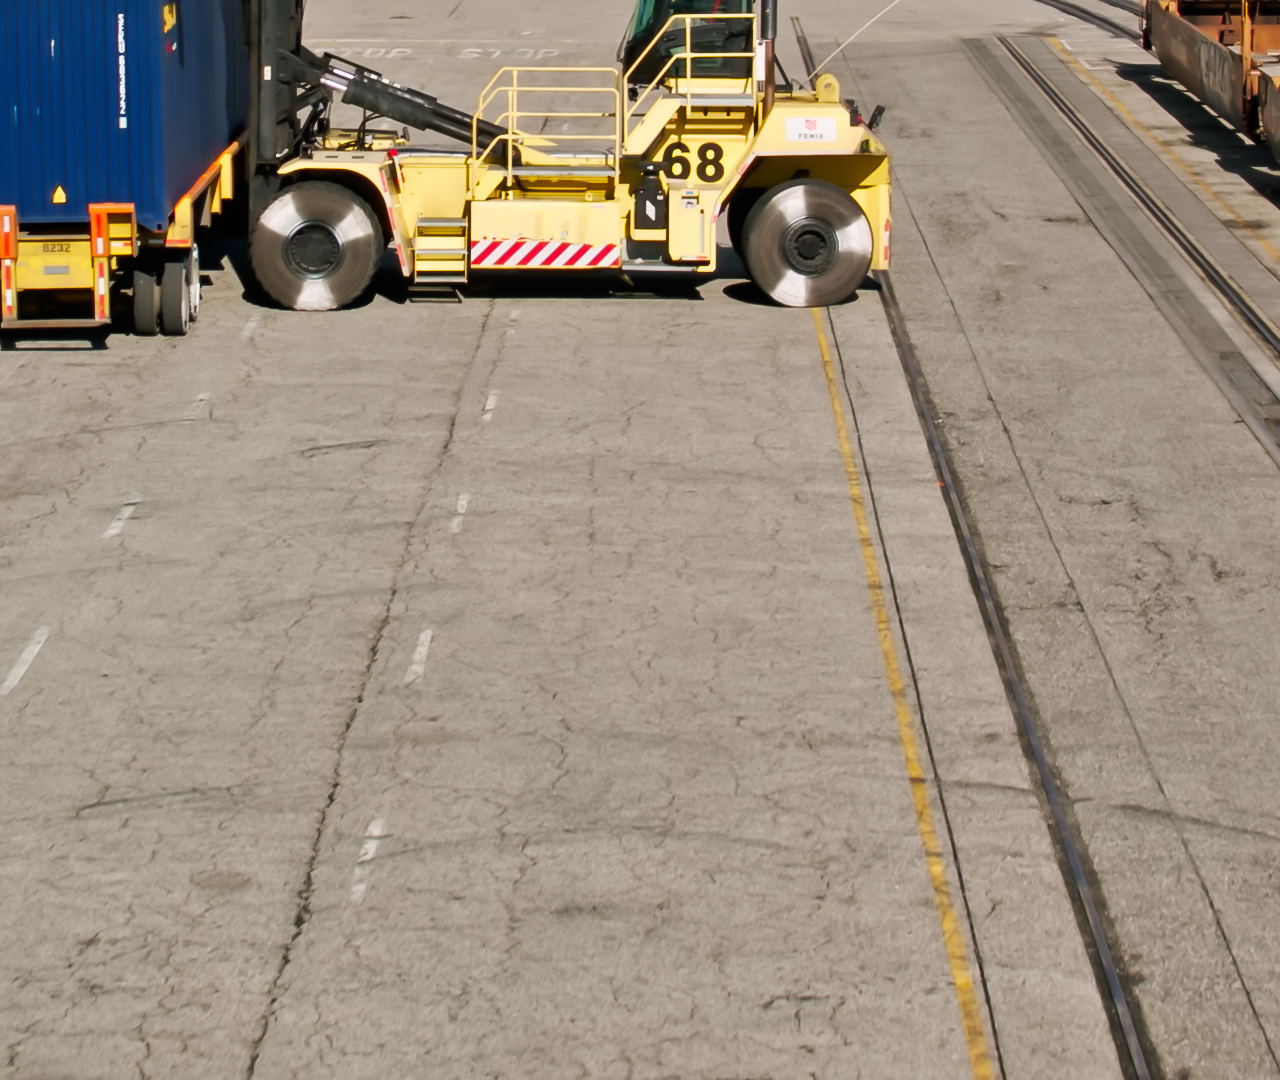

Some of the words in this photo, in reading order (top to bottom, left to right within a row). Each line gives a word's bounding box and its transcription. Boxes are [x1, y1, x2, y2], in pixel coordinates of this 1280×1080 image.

[458, 48, 560, 59] STOP
[662, 142, 725, 183] 68
[43, 243, 71, 253] B232
